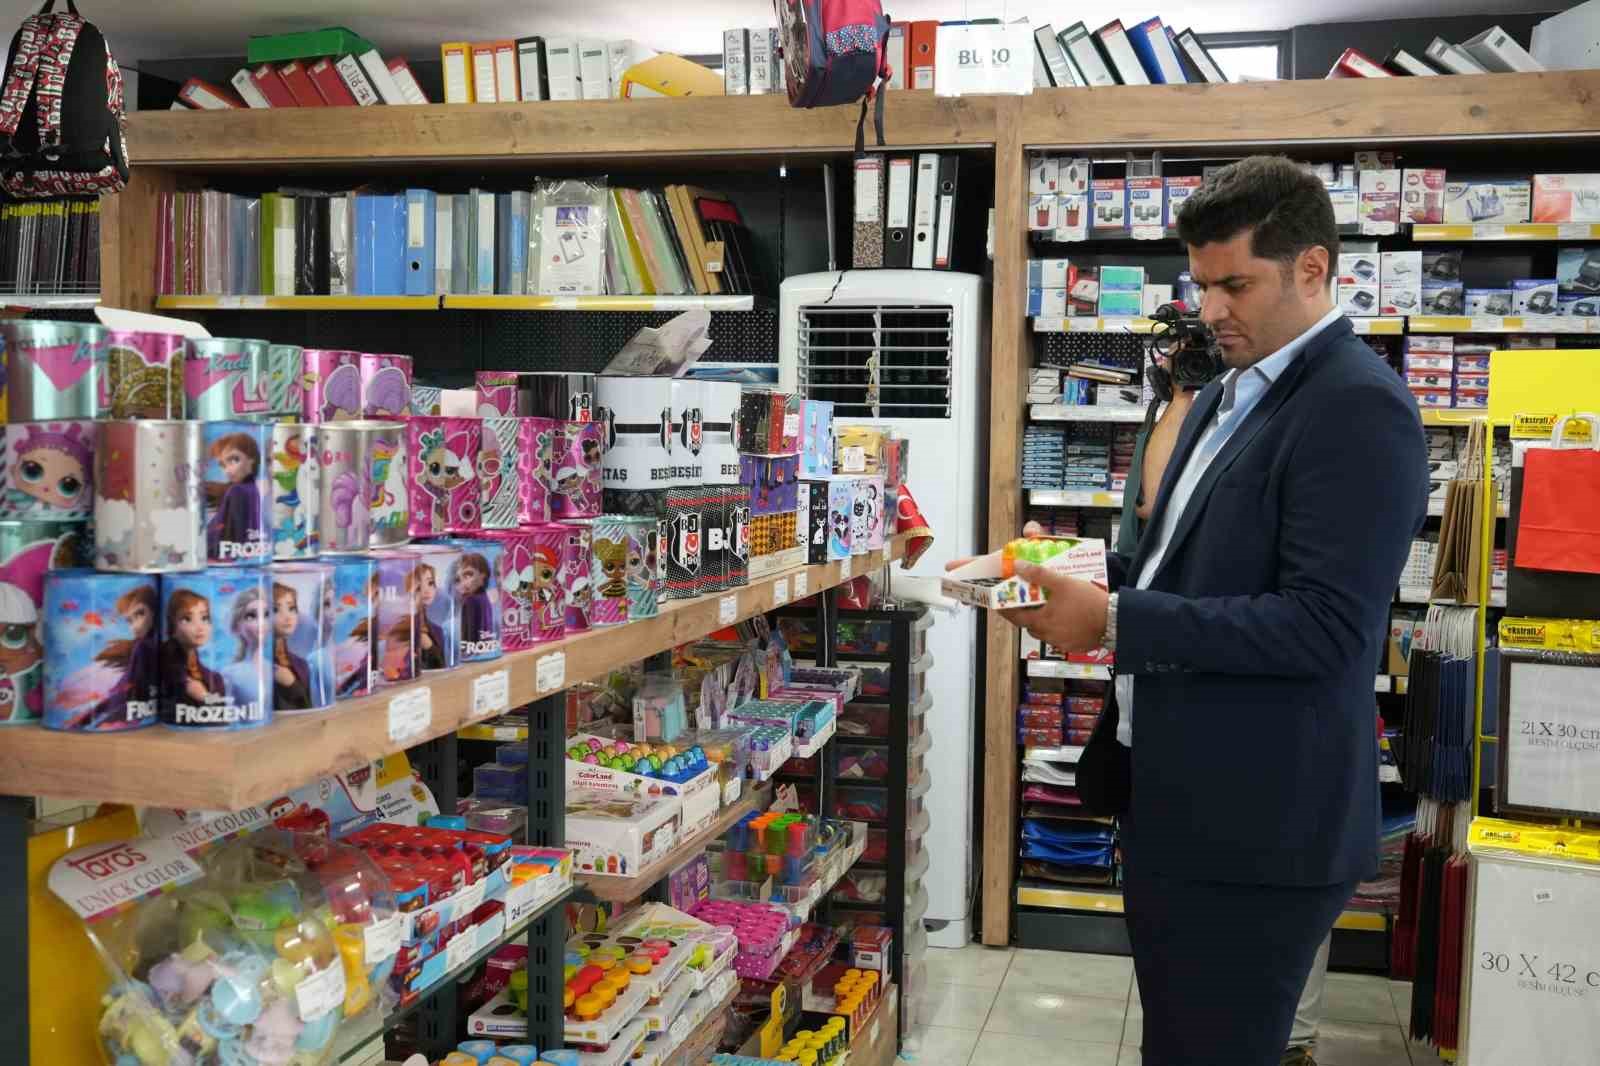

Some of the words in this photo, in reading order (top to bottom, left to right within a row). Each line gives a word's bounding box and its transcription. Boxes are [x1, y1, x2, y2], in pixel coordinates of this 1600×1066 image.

[176, 704, 246, 723] FROZEN
[1539, 721, 1552, 736] X
[1557, 723, 1577, 738] 30
[213, 806, 263, 833] COLOR
[135, 858, 191, 889] COLOR
[1480, 951, 1510, 973] 30
[1519, 953, 1537, 978] X
[1546, 962, 1577, 984] 42
